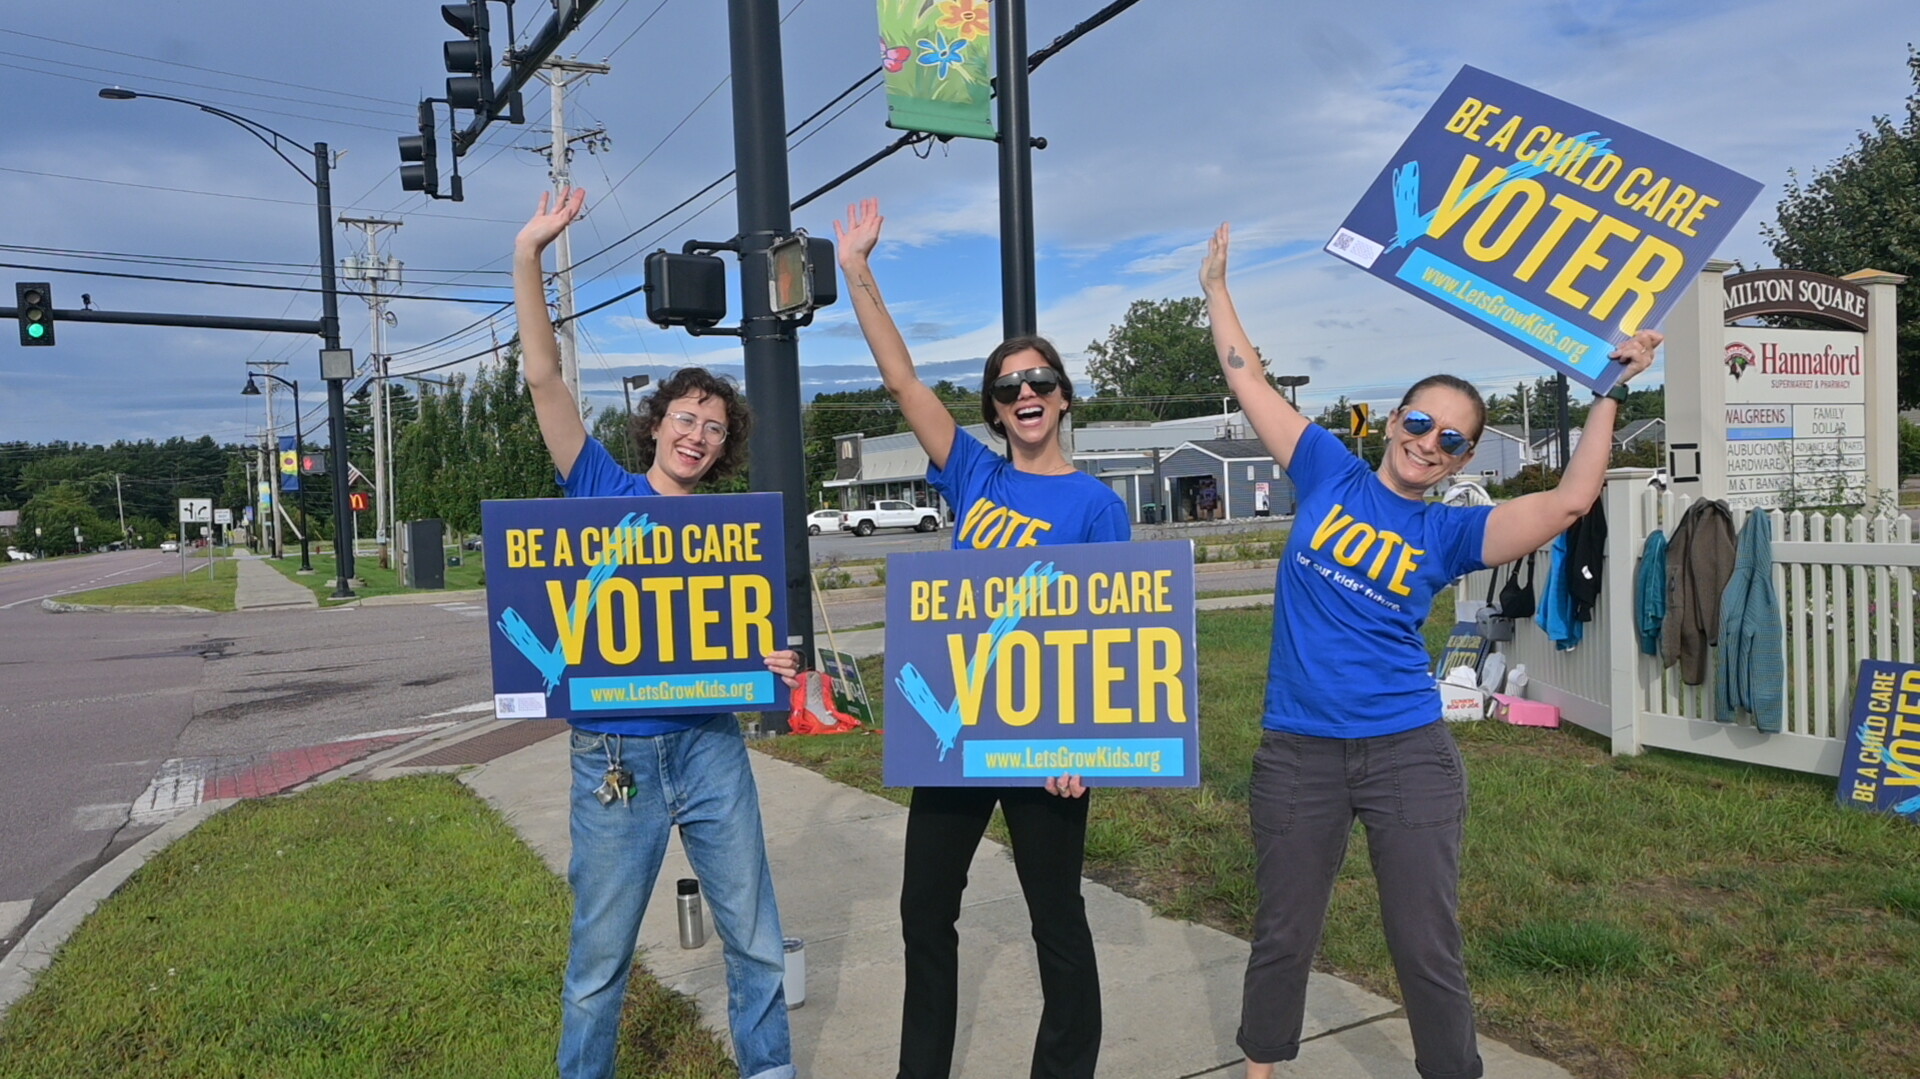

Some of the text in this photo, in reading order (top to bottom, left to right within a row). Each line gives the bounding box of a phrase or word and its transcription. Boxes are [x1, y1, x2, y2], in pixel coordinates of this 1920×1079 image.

[1445, 96, 1720, 238] BE A CHILD CARE
[1425, 154, 1684, 337] VOTER
[1421, 265, 1590, 364] www.LetsGrowKids.org
[1723, 279, 1866, 318] MILTON SQUARE
[1760, 343, 1860, 375] Hannaford
[1771, 380, 1850, 389] SUPERMARKET & PHARMACY
[1812, 422, 1846, 434] DOLLAR
[1814, 408, 1844, 419] FAMILY
[1727, 443, 1782, 456] AUBUCHON
[1728, 458, 1781, 471] HARDWARE
[1728, 479, 1737, 490] M
[1739, 478, 1746, 490] &
[1748, 478, 1753, 489] T
[506, 522, 762, 568] BE A CHILD CARE
[958, 498, 1052, 550] VOTE
[1310, 504, 1425, 596] VOTE
[910, 570, 1172, 621] BE A CHILD CARE
[1296, 552, 1401, 612] for our kids' future.
[545, 574, 776, 666] VOTER
[591, 681, 754, 702] www.LetsGrowKids.org
[946, 626, 1187, 727] VOTER
[985, 746, 1161, 772] www.LetsGrowKids.org
[1852, 670, 1896, 802] BE A CHILD CARE
